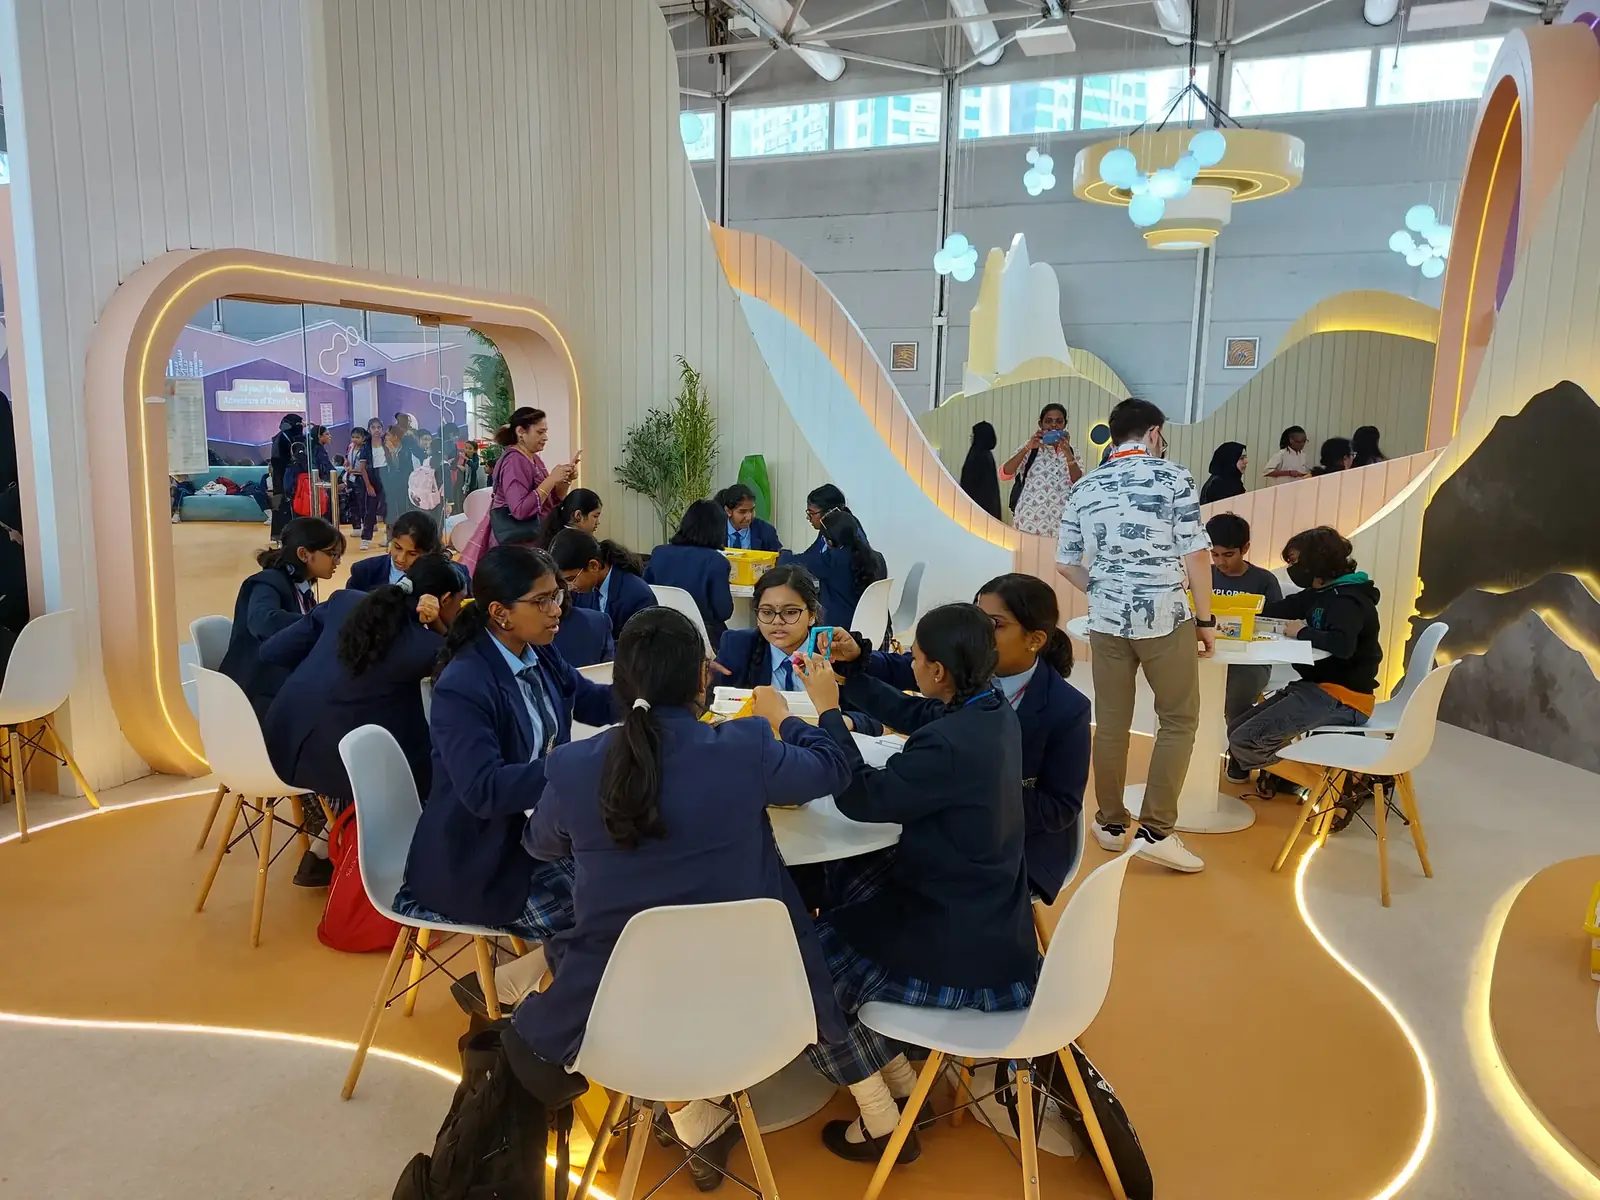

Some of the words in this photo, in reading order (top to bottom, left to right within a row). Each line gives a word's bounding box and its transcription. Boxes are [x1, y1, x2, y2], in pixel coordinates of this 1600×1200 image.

[224, 396, 259, 405] Adventure
[260, 397, 267, 405] of
[268, 397, 302, 408] Knowledge
